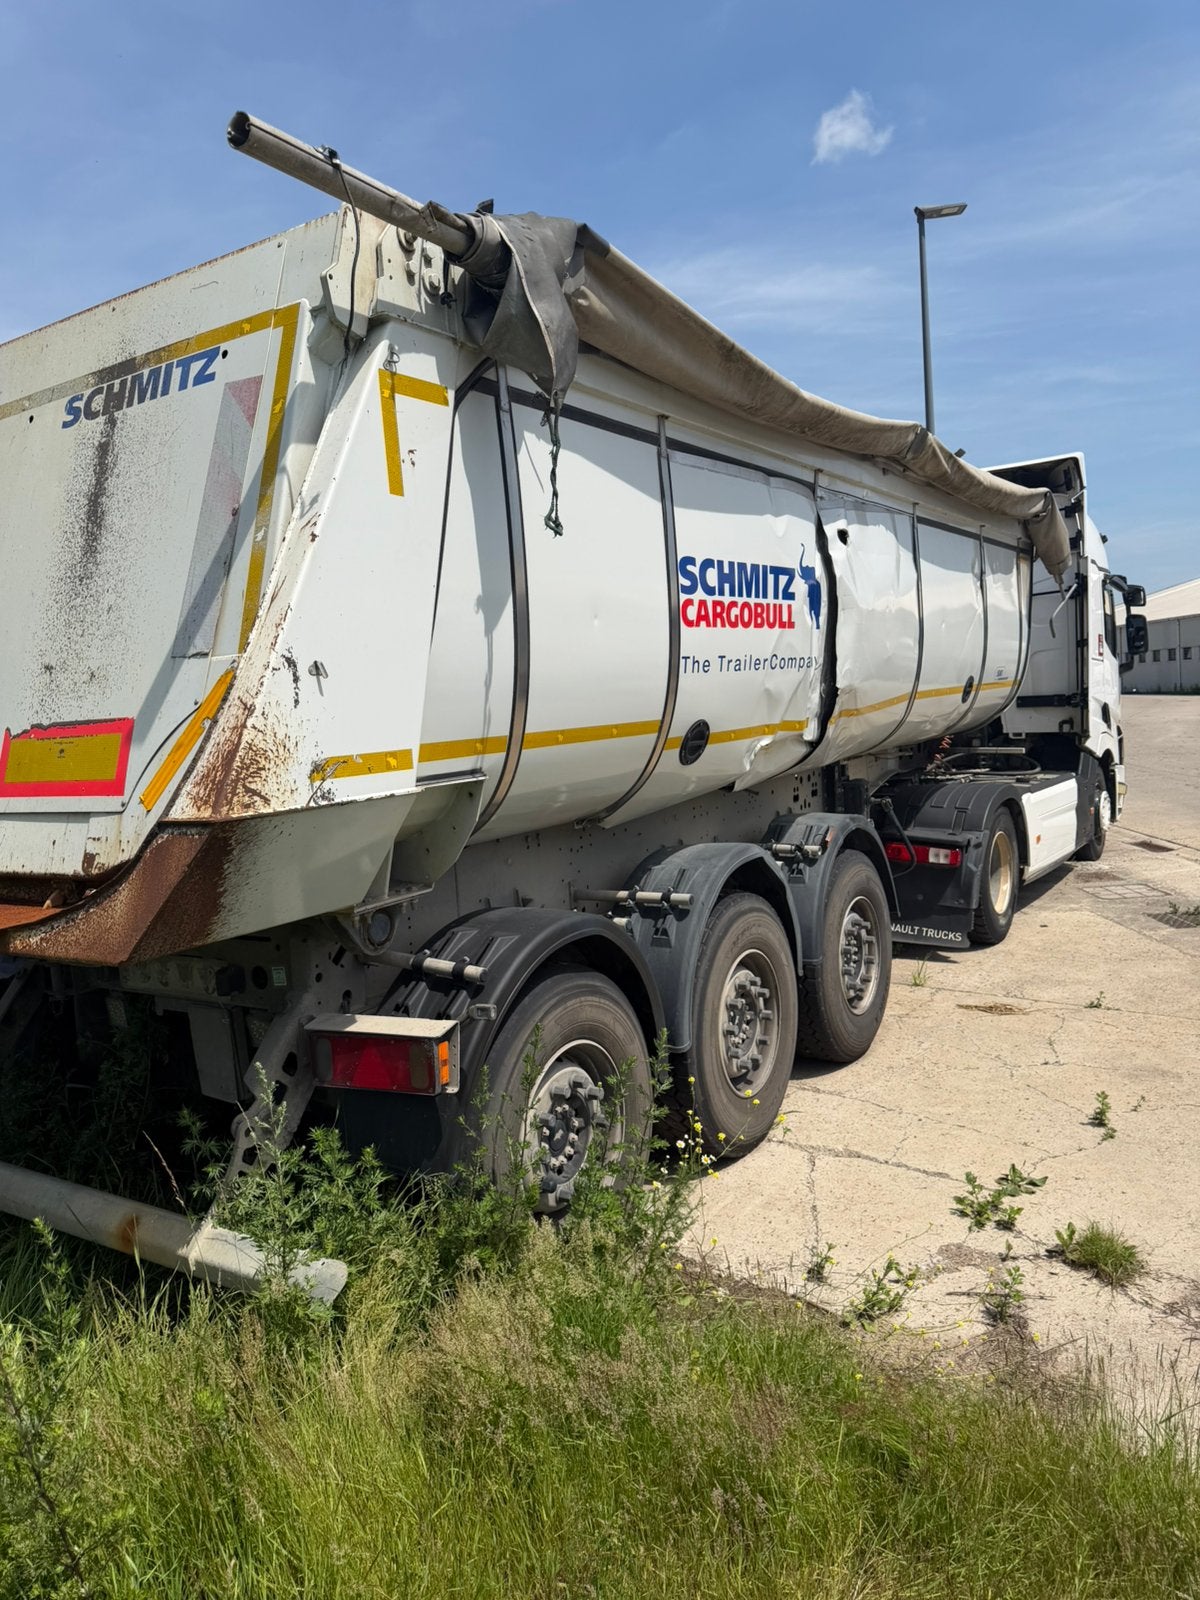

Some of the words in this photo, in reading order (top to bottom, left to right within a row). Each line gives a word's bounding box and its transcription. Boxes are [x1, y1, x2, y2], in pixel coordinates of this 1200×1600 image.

[61, 345, 221, 429] SCHMITZ
[678, 555, 796, 601] SCHMITZ
[681, 598, 796, 630] CARGOBULL
[681, 655, 711, 674] The
[890, 922, 920, 936] NAULT
[921, 927, 962, 942] TRUCKS
